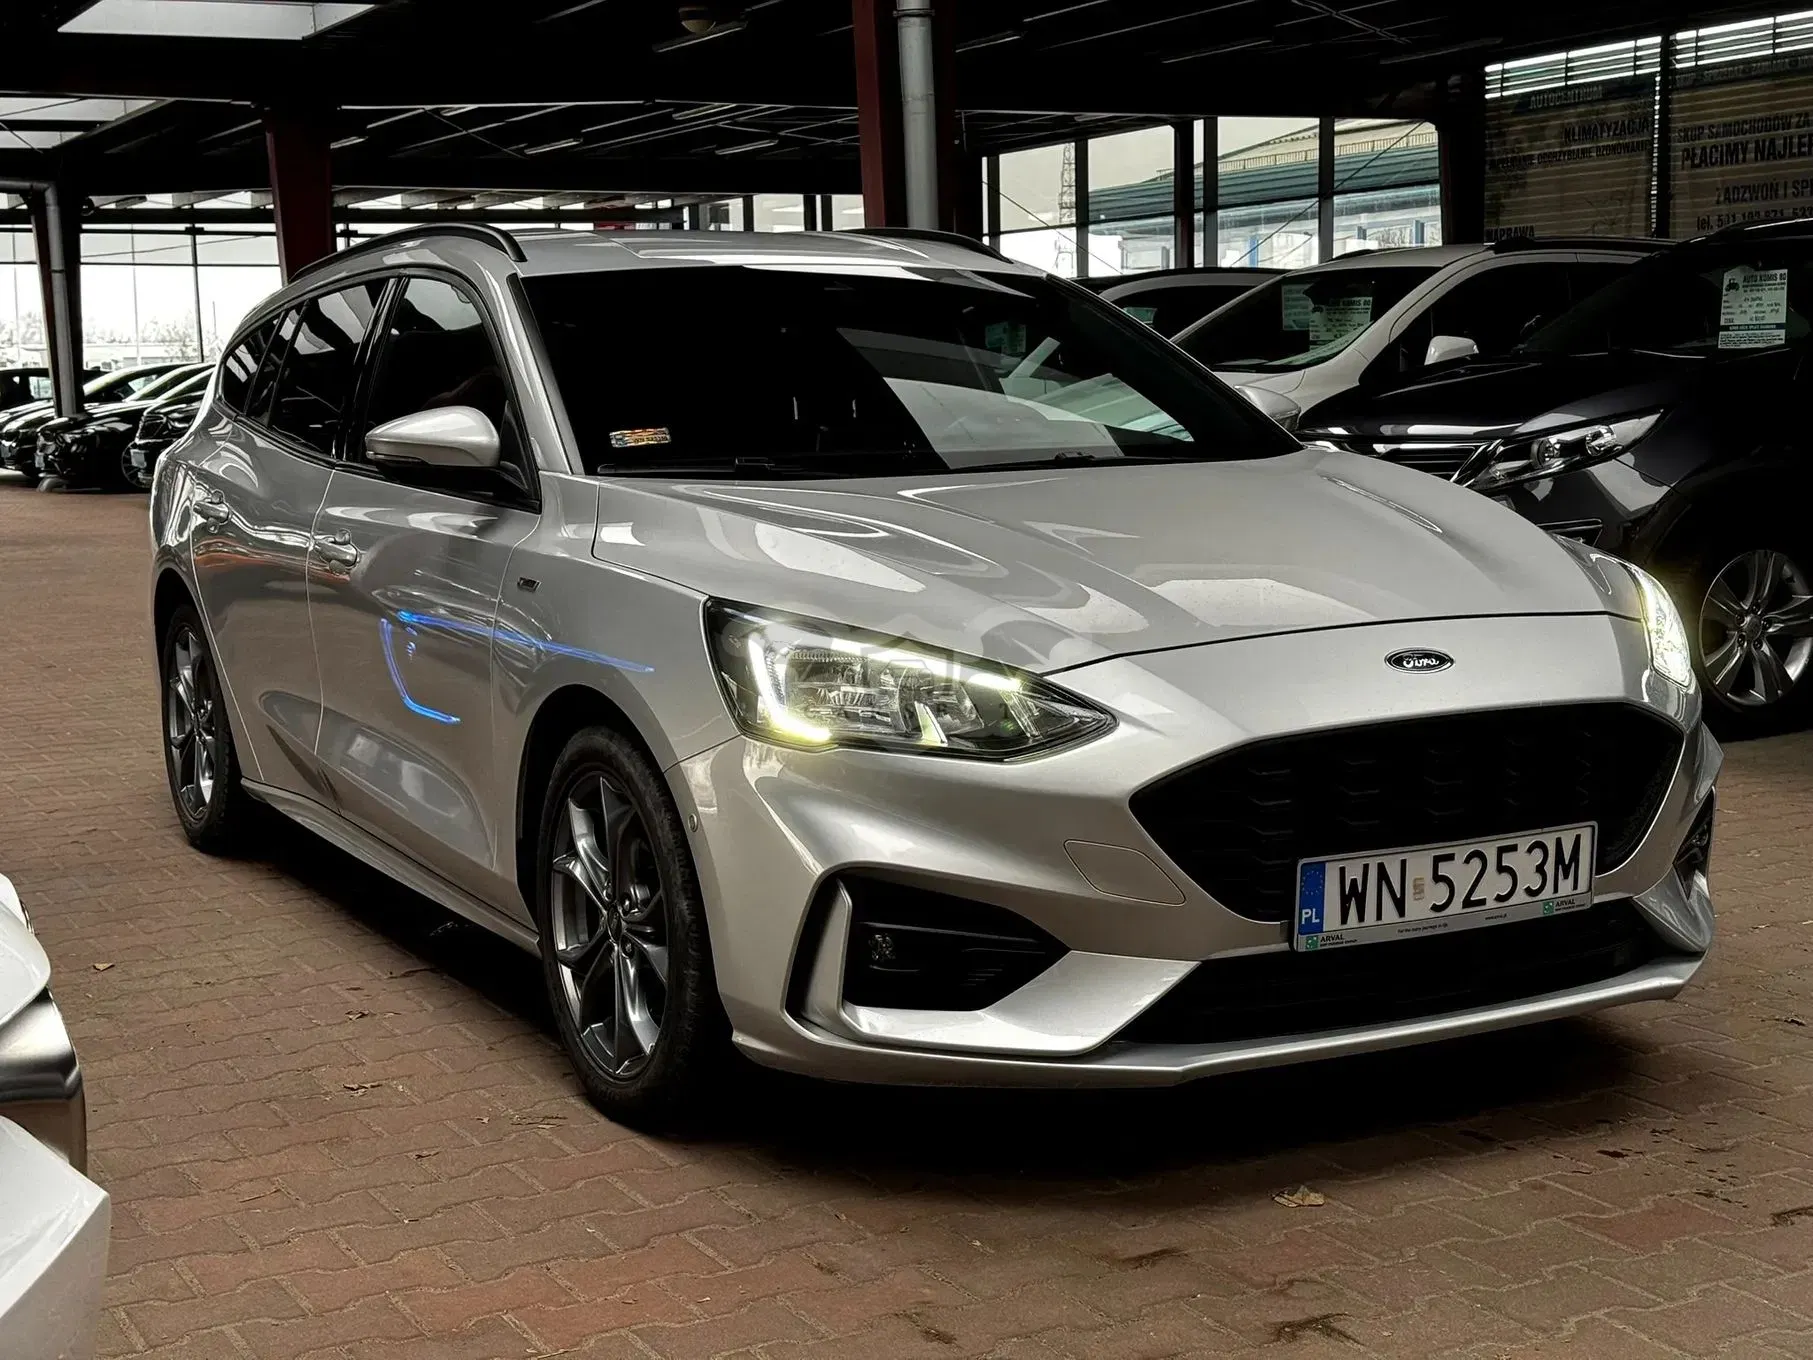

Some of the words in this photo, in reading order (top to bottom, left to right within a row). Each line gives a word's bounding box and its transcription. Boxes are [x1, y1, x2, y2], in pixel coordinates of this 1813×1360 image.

[1563, 117, 1649, 142] KLIMATYZACJA
[1677, 124, 1704, 143] SKUP
[1708, 113, 1792, 139] SAMOCHODÓW
[1795, 112, 1810, 128] ZA
[1681, 140, 1749, 170] PŁACIMY
[1716, 178, 1779, 204] ZADZWOŃ
[1783, 180, 1788, 199] I
[1697, 215, 1713, 231] tel.
[1339, 858, 1407, 926] WN
[1430, 833, 1582, 913] 5253M
[1556, 899, 1576, 907] ARVAL
[1301, 908, 1320, 925] PL
[1320, 934, 1344, 942] ARVAL
